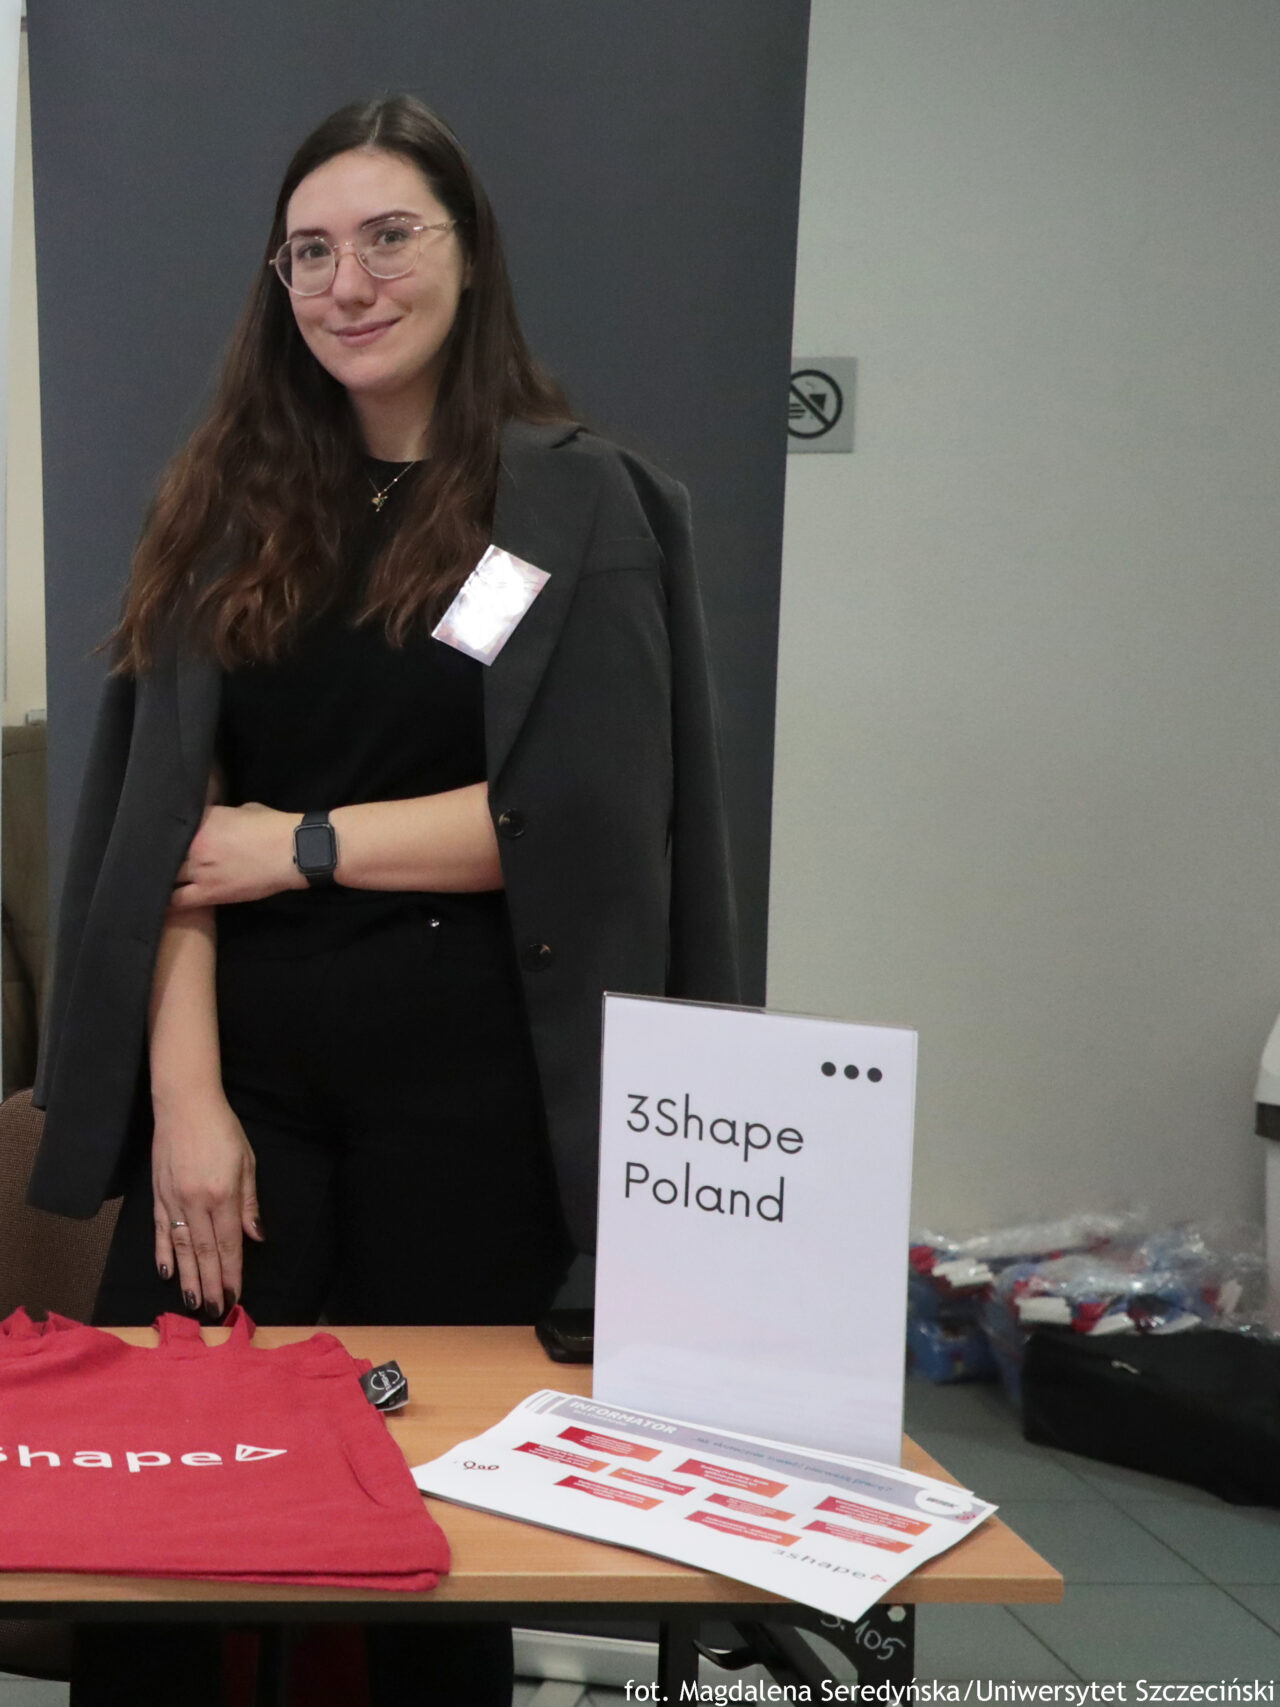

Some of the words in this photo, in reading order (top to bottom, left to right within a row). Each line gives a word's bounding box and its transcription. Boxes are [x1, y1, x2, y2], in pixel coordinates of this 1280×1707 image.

[626, 1093, 804, 1162] 3Shape
[625, 1161, 785, 1223] Poland
[569, 1401, 678, 1435] INFORMATOR
[772, 1548, 866, 1579] 3shape
[855, 1619, 907, 1661] 105
